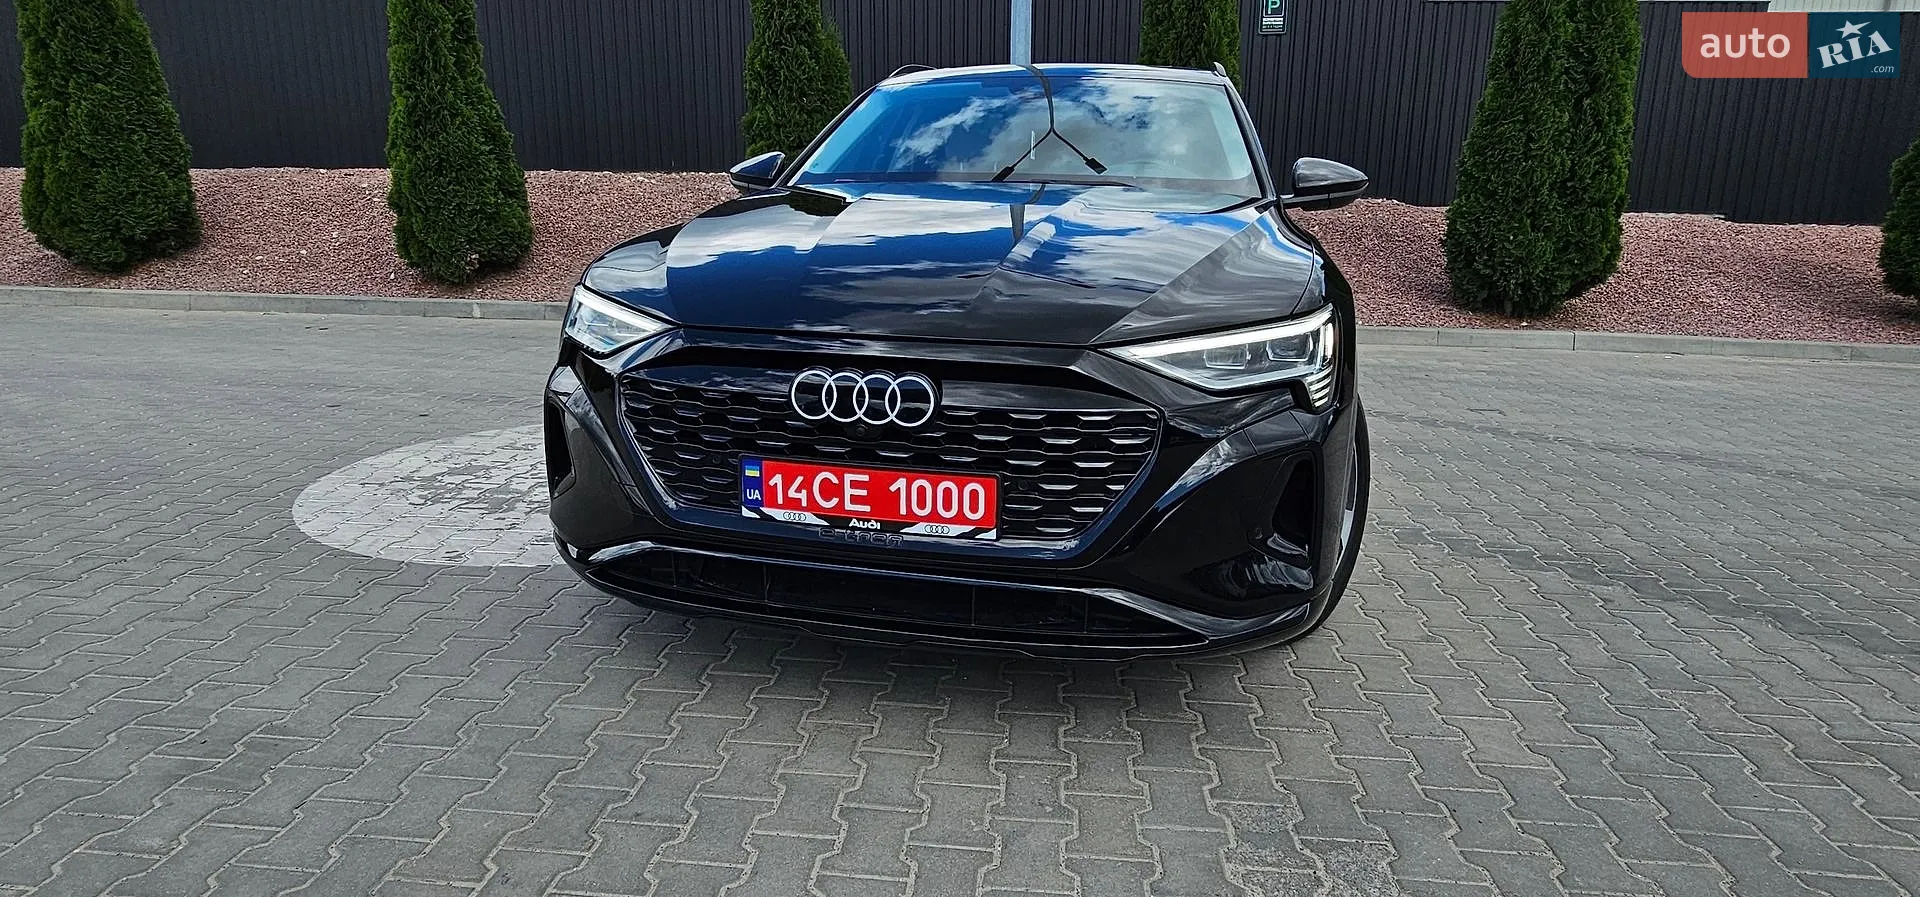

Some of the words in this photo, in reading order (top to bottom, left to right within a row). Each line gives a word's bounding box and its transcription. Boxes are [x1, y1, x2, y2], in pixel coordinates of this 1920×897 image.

[1268, 0, 1280, 14] P
[746, 488, 761, 501] UA
[888, 477, 986, 521] 1000
[848, 518, 881, 530] Audi
